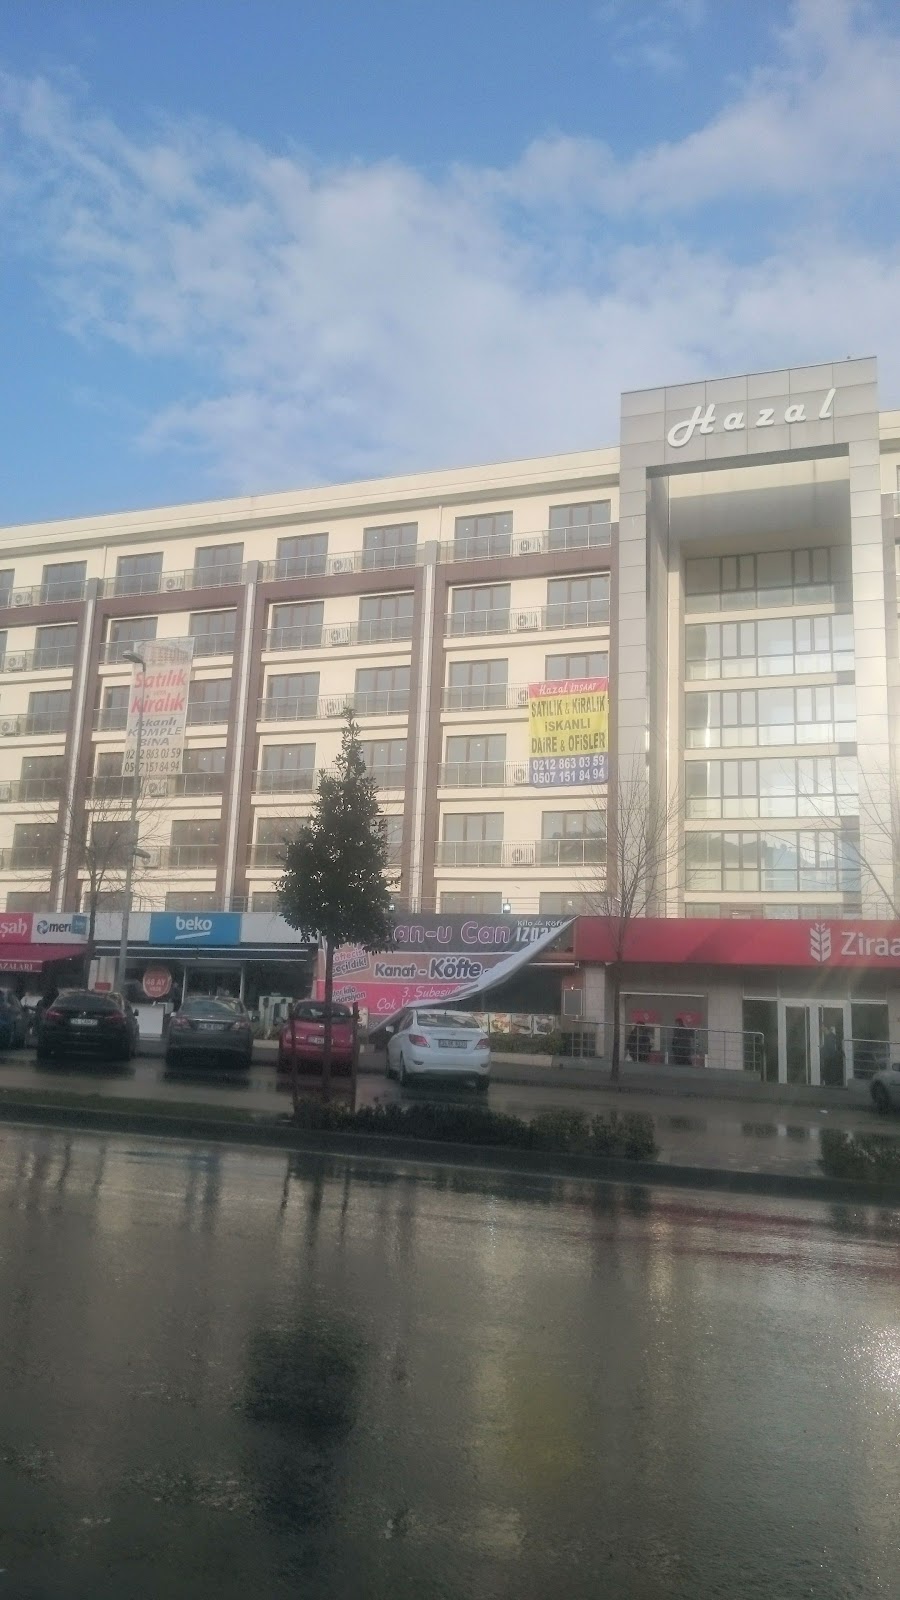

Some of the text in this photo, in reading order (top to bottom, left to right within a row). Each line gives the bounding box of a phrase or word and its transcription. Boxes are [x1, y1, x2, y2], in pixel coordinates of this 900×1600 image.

[667, 387, 836, 447] Hazal
[531, 700, 562, 718] SATILIK
[125, 749, 145, 760] 022
[532, 754, 605, 771] 0212 863 03 59
[124, 761, 144, 773] 057
[532, 767, 605, 783] 0507 151 84 94
[176, 916, 213, 931] beko
[461, 921, 510, 944] Can
[375, 963, 417, 978] Kanat
[429, 955, 482, 979] Köfte
[376, 998, 396, 1011] Çok
